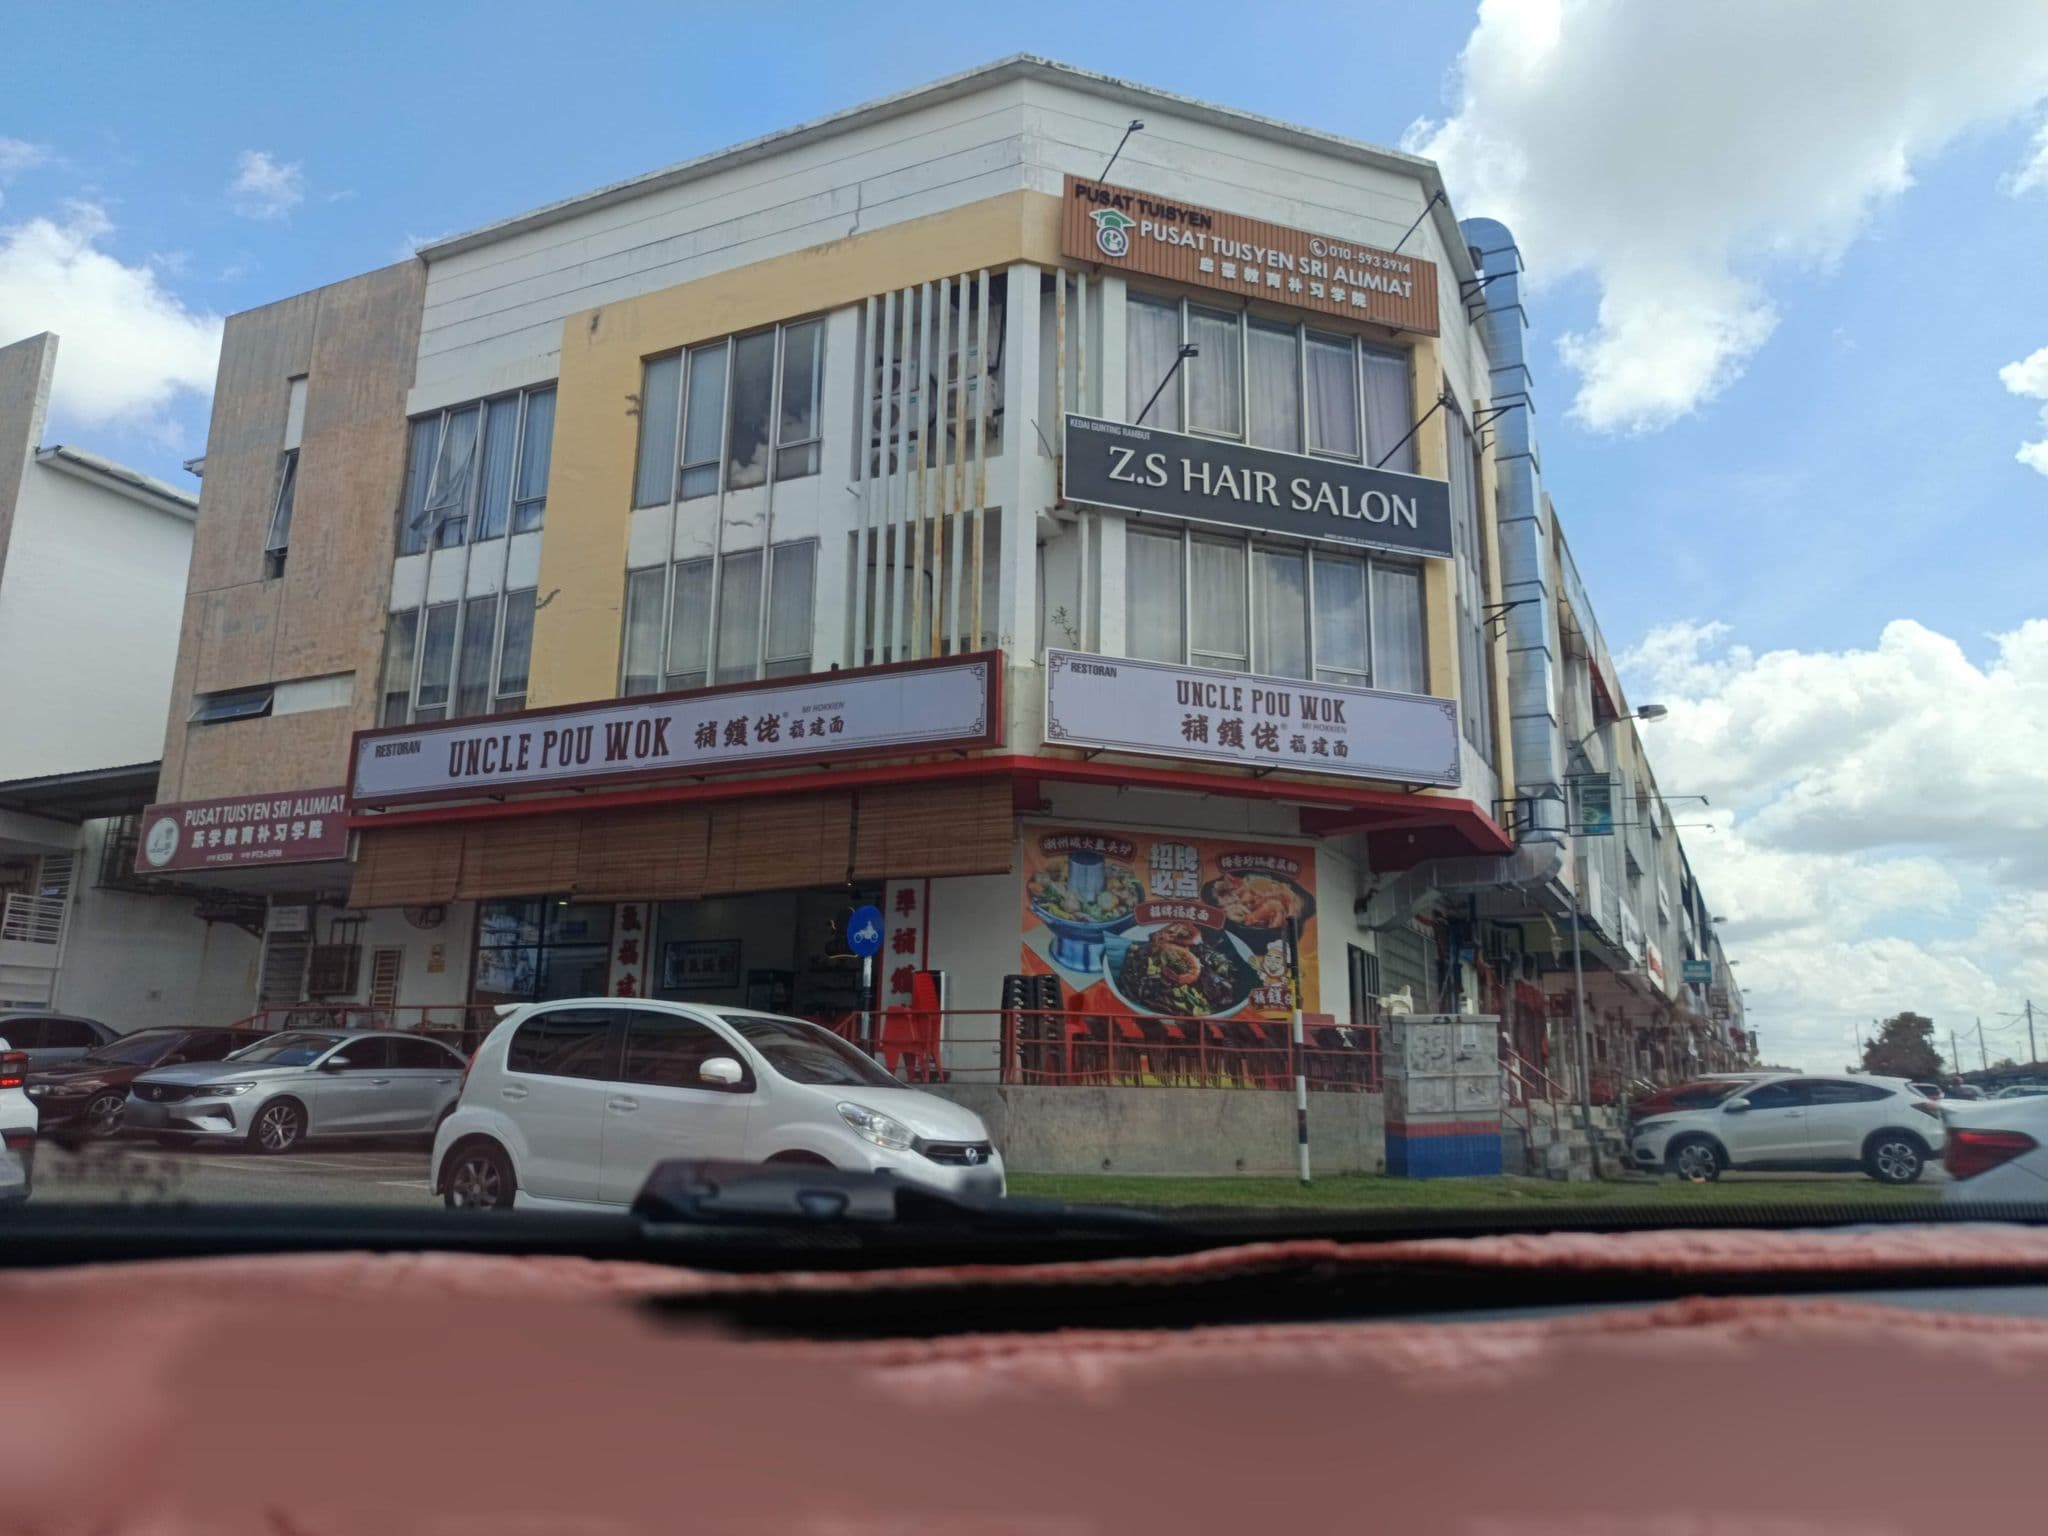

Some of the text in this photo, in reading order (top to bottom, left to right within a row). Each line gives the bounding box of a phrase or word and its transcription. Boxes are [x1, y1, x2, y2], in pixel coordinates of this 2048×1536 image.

[1074, 183, 1213, 229] PUSAT TUISYEN
[1140, 219, 1413, 299] PUSAT TUISYEN SRI ALIMIAT
[1108, 446, 1417, 529] Z.S HAIR SALON
[1070, 662, 1118, 678] RESTORAN
[1176, 680, 1347, 724] UNCLE POU WOK
[374, 740, 421, 758] RESTORAN
[448, 716, 673, 778] UNCLE POU WOK
[184, 795, 346, 827] PUSAT TUISYEN SRI ALIMIAT
[1150, 844, 1198, 871] 招牌
[1151, 870, 1199, 897] 必点
